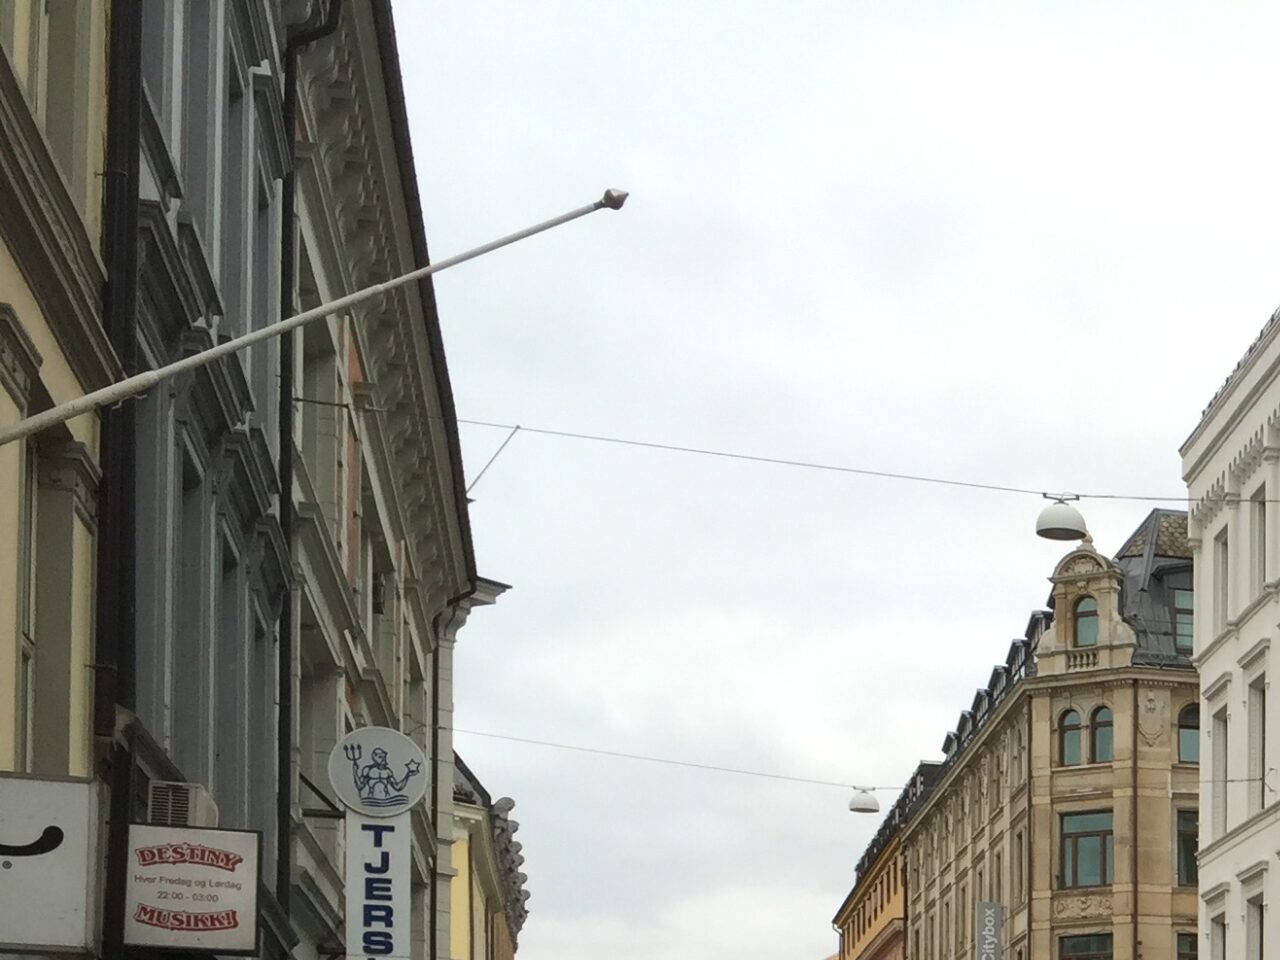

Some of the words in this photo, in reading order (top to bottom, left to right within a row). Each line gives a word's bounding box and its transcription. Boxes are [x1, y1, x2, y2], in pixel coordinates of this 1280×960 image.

[136, 844, 243, 871] DESTINY
[134, 875, 156, 885] Hver
[160, 876, 192, 888] Fredag
[194, 880, 206, 889] og
[157, 891, 184, 900] 22:00
[134, 903, 238, 930] MUSIKK!
